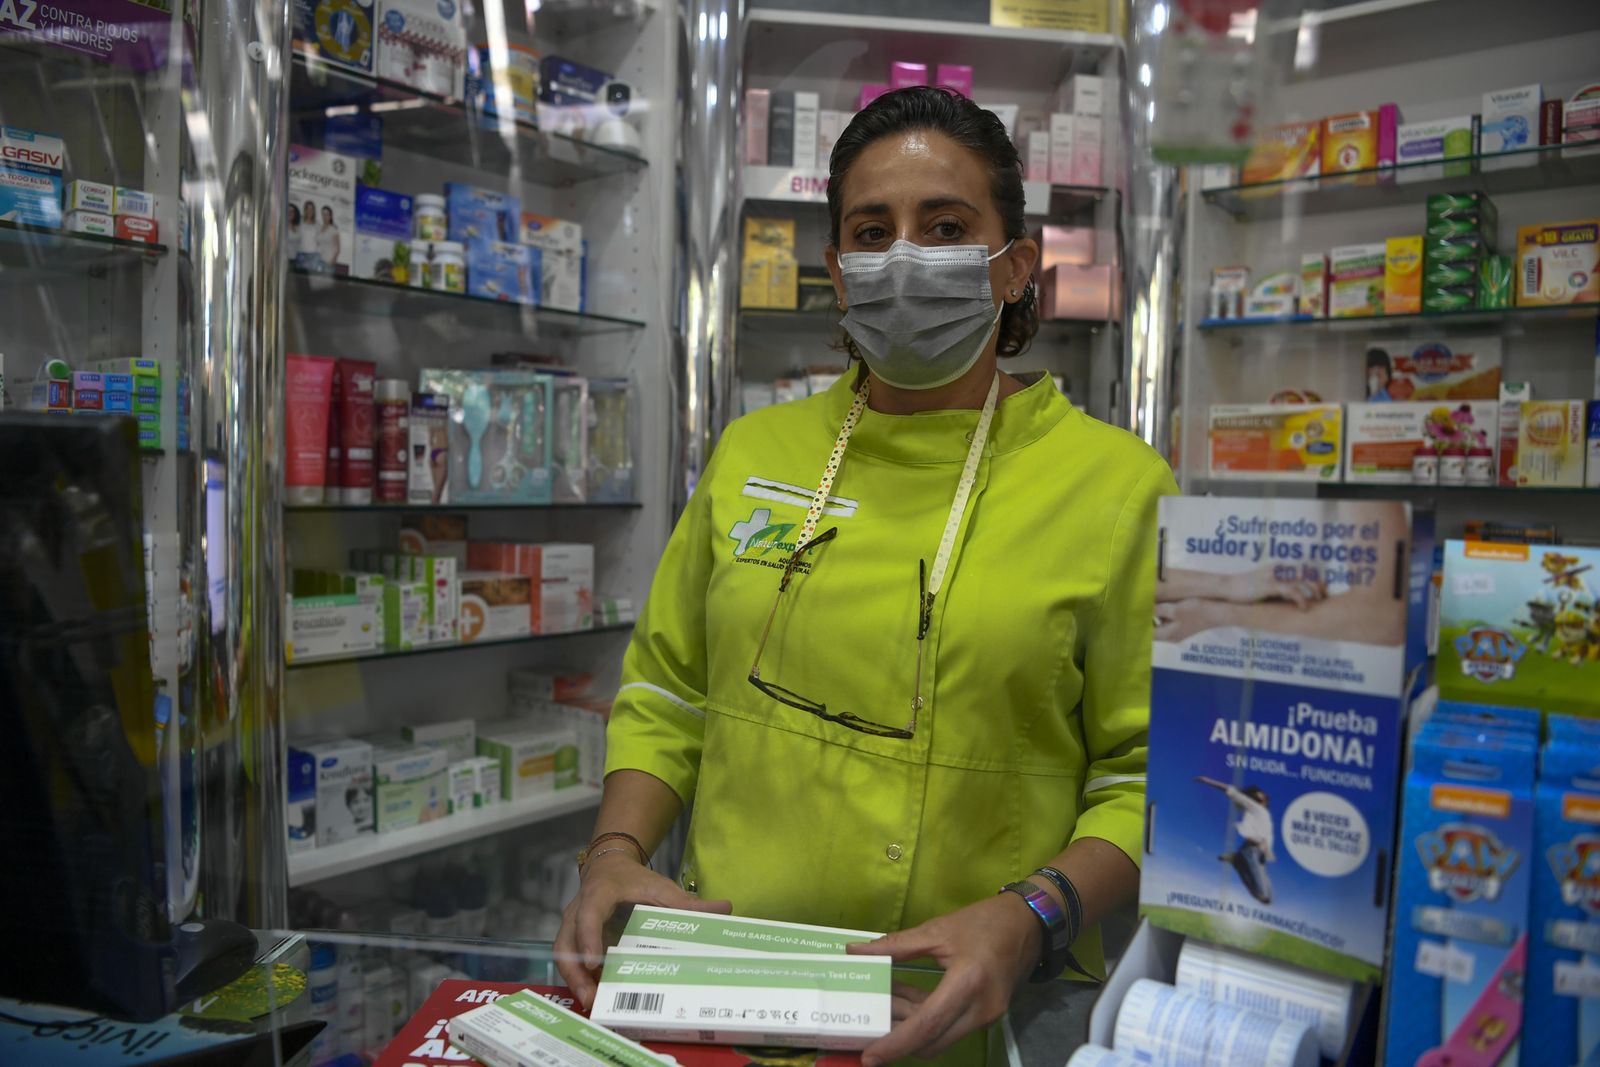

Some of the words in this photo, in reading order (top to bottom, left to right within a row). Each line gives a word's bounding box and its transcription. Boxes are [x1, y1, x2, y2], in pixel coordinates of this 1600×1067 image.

[40, 4, 93, 31] CONTRA
[96, 20, 139, 43] PIOJOS
[40, 20, 48, 31] Y
[51, 22, 113, 52] LIENDRES
[0, 145, 60, 166] GASIV
[1322, 522, 1355, 543] por
[1360, 521, 1381, 541] el
[736, 557, 760, 565] EXPERTOS
[767, 561, 785, 569] SALUD
[1186, 534, 1247, 557] sudor
[1252, 541, 1265, 562] y
[1269, 536, 1303, 560] los
[1310, 543, 1378, 565] roces
[1273, 565, 1297, 583] en
[1301, 562, 1319, 584] la
[1324, 564, 1377, 587] piel?
[1287, 702, 1379, 736] ¡Prueba
[1210, 717, 1376, 769] ALMIDONA!
[1300, 763, 1373, 791] FUNCIONA
[640, 918, 700, 932] BOSON
[722, 929, 747, 938] Rapid
[748, 930, 799, 945] SARS-CoV-2
[800, 939, 833, 950] Antigen
[617, 960, 680, 975] BOSON
[707, 965, 733, 975] Rapid
[829, 971, 847, 979] Test
[849, 972, 871, 980] Card
[810, 1011, 871, 1025] COVID-19
